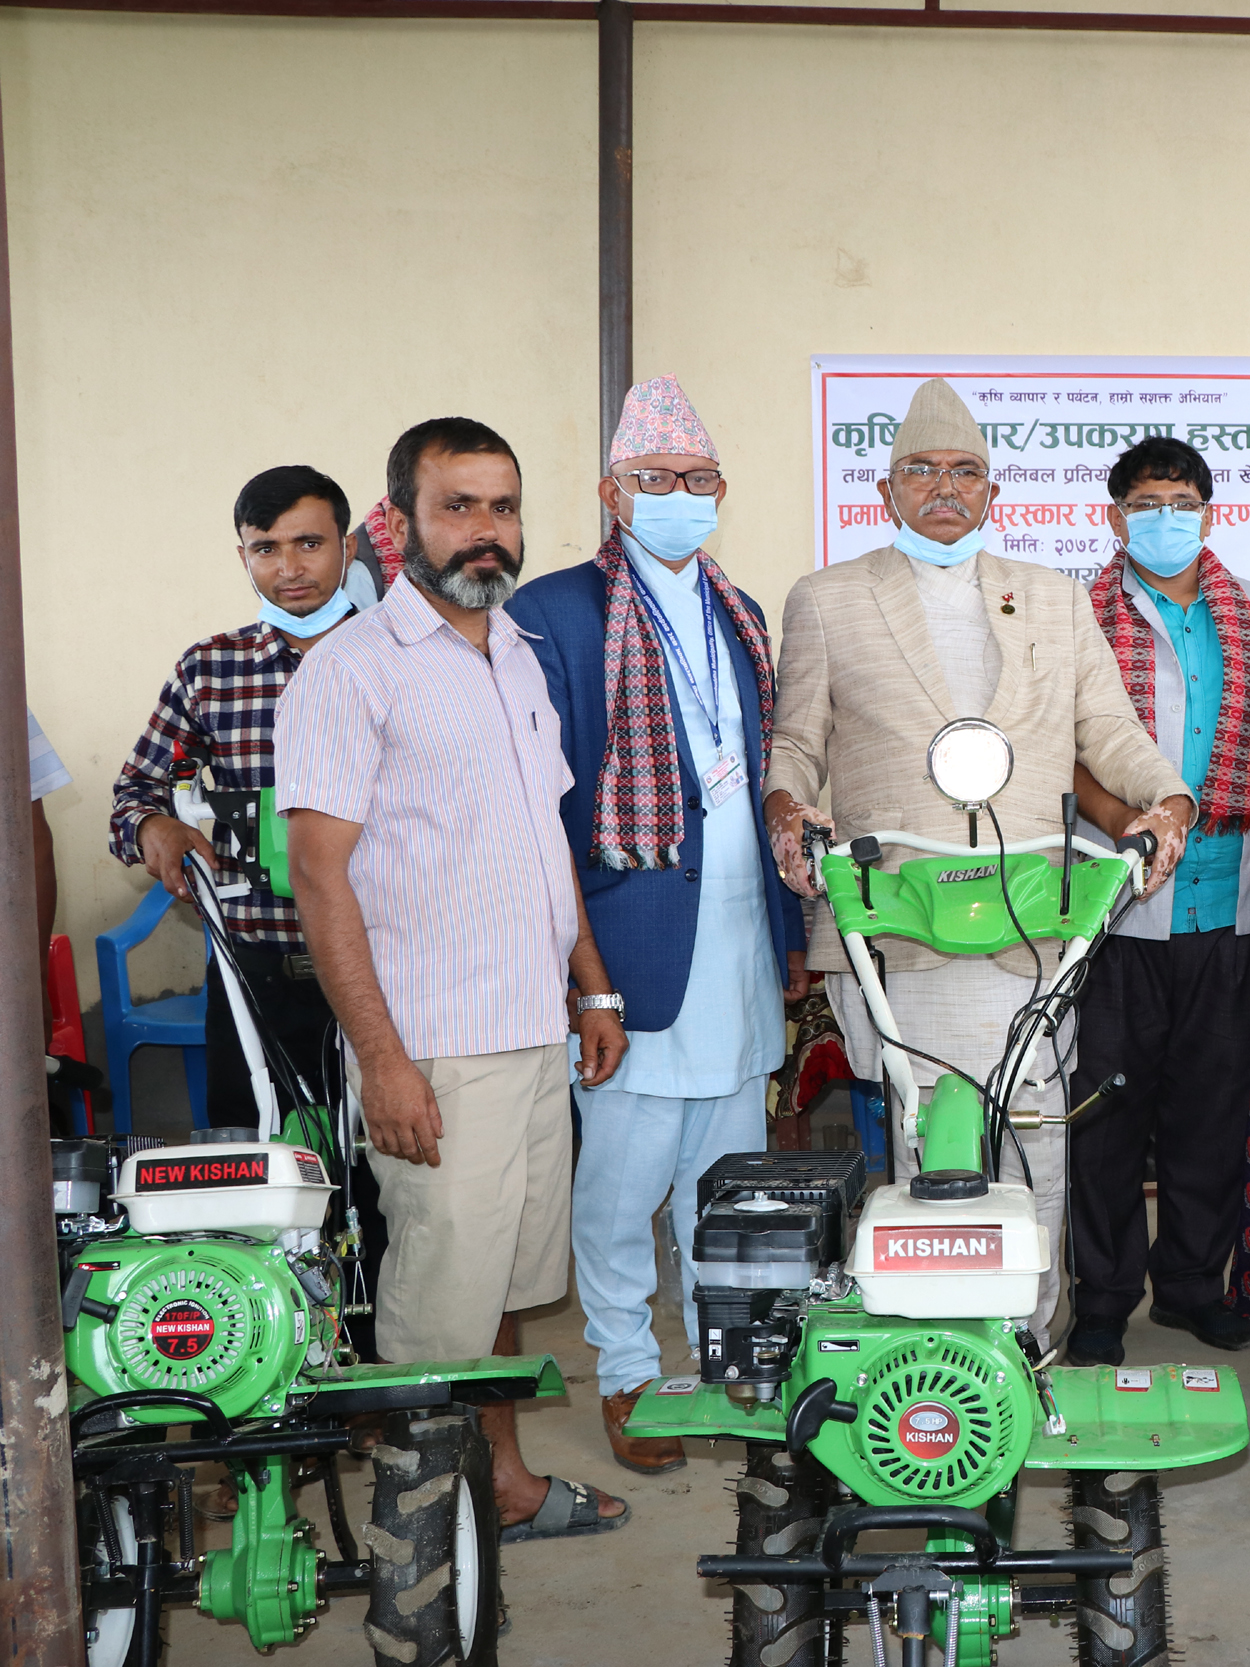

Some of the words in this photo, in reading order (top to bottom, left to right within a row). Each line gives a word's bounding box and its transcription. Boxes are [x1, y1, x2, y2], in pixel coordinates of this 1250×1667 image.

[1010, 391, 1047, 404] व्यापार
[1053, 392, 1062, 404] र
[1108, 390, 1134, 404] हाम्रो
[842, 468, 876, 484] तथा
[1064, 464, 1112, 485] प्रतियो
[990, 504, 1078, 532] पुरस्कार
[938, 864, 998, 883] KISHAN
[140, 1165, 186, 1184] NEW
[190, 1161, 264, 1181] KISHAN
[888, 1238, 987, 1258] KISHAN
[154, 1300, 188, 1322] ELECTRONIC
[188, 1300, 210, 1320] IGNITION
[165, 1311, 201, 1320] 170F/P
[156, 1324, 176, 1333] NEW
[178, 1324, 210, 1332] KISHAN
[167, 1338, 198, 1353] 7.5
[906, 1432, 953, 1443] KISHAN
